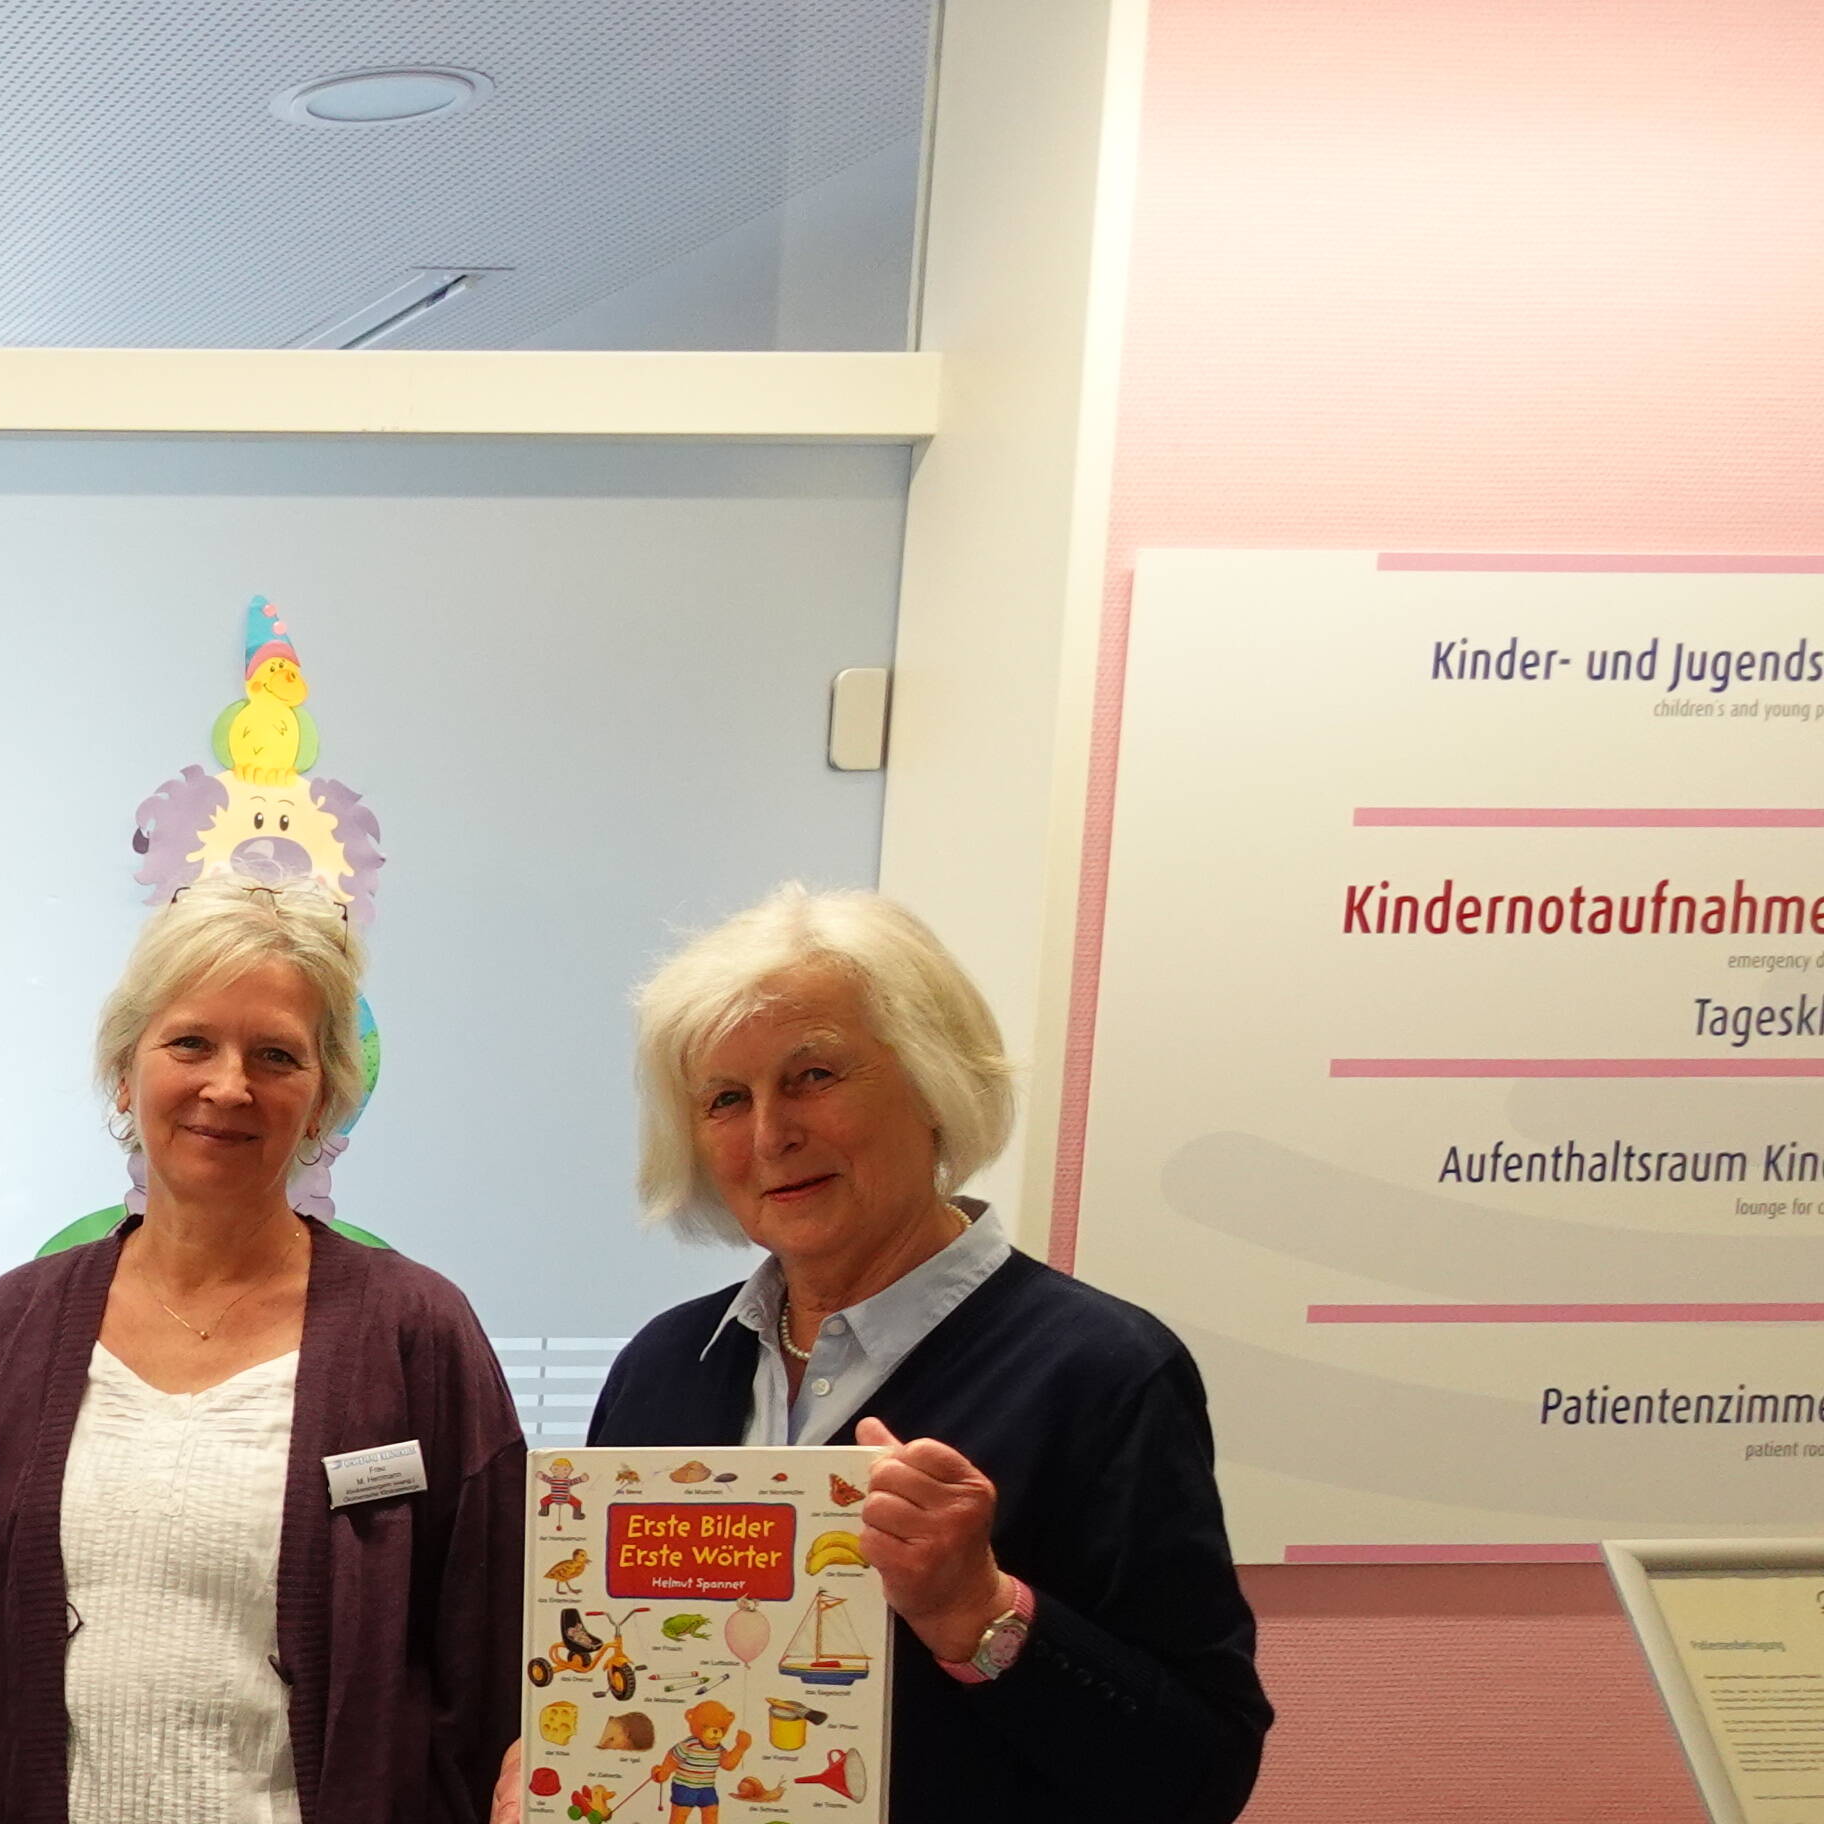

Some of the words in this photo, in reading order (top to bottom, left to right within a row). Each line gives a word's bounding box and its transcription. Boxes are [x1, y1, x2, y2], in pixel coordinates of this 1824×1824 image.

[1432, 637, 1570, 680] Kinder-
[1586, 638, 1658, 681] und
[1667, 638, 1824, 693] Jugends
[1730, 699, 1759, 717] and
[1764, 702, 1811, 721] young
[1728, 954, 1810, 973] emergency
[1438, 1140, 1747, 1183] Aufenthaltsraum
[1763, 1141, 1824, 1182] Kin
[1735, 1198, 1787, 1219] lounge
[1791, 1198, 1813, 1215] for
[1745, 1442, 1799, 1461] patient
[627, 1513, 690, 1539] Erste
[700, 1513, 776, 1539] Bilder
[618, 1543, 684, 1569] Erste
[693, 1542, 783, 1570] Wörter
[652, 1576, 693, 1590] Helmut
[695, 1577, 747, 1593] Spanner
